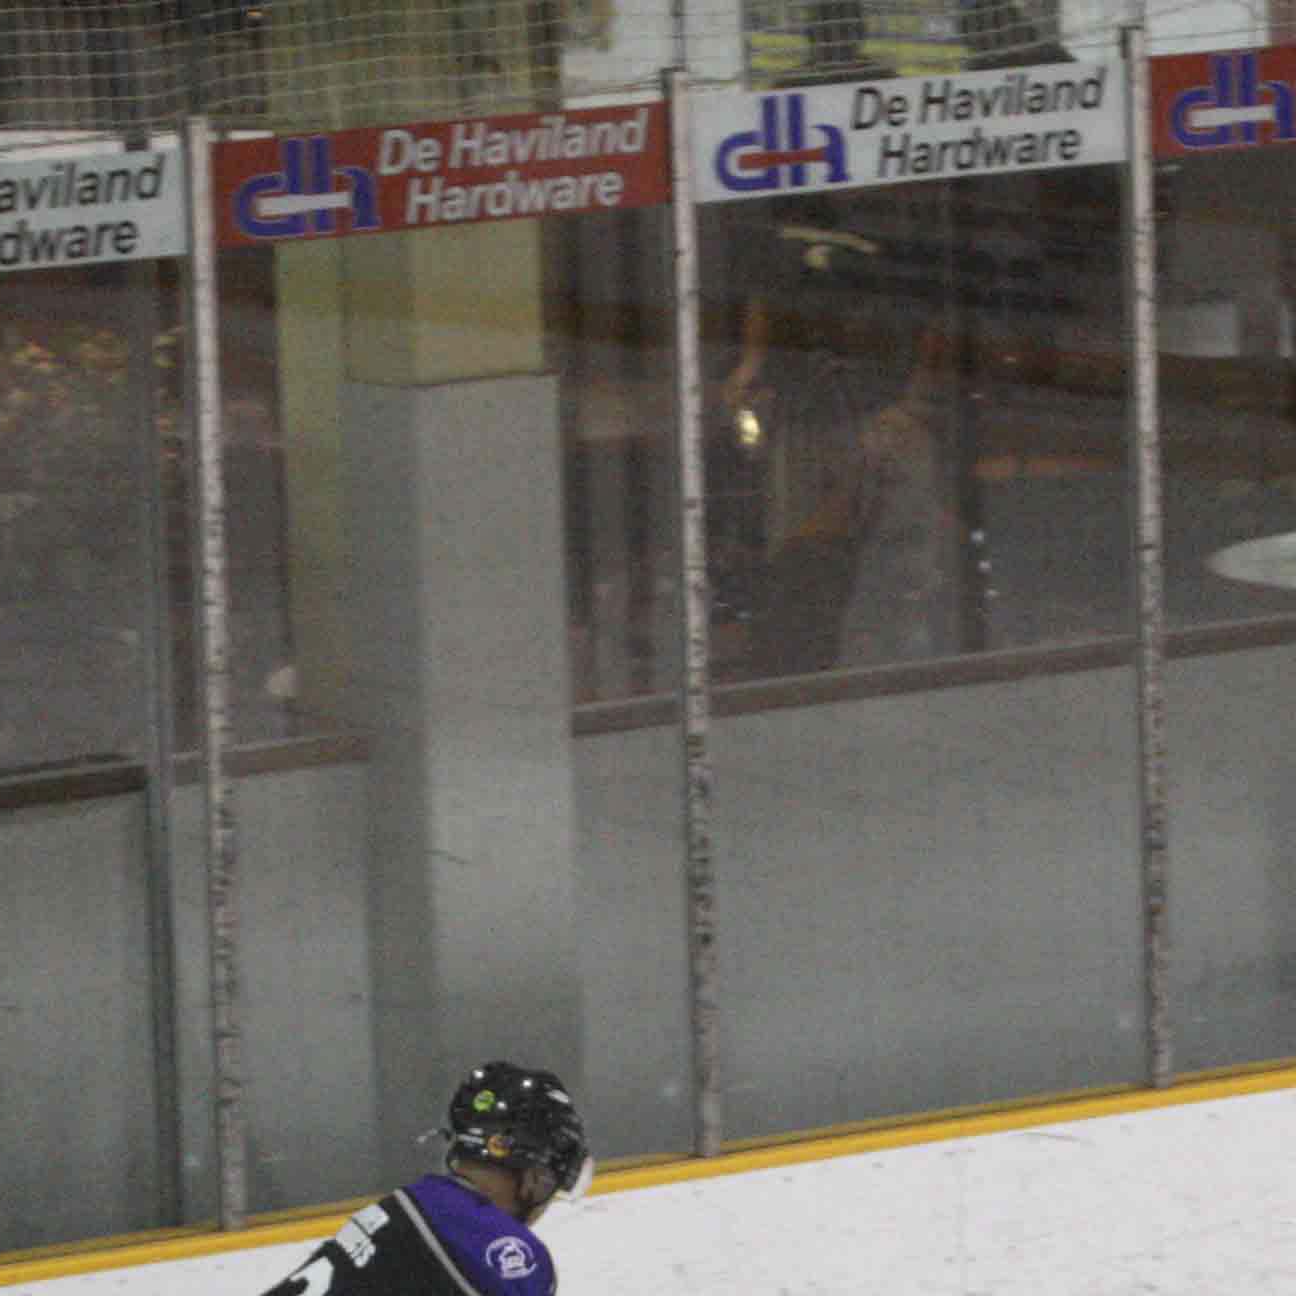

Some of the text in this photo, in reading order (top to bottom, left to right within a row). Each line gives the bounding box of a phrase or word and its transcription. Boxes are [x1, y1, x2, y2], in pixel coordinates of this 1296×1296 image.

[851, 67, 1108, 130] De Haviland
[378, 108, 649, 176] De Haviland
[878, 125, 1081, 178] Hardware
[406, 170, 624, 225] Hardware
